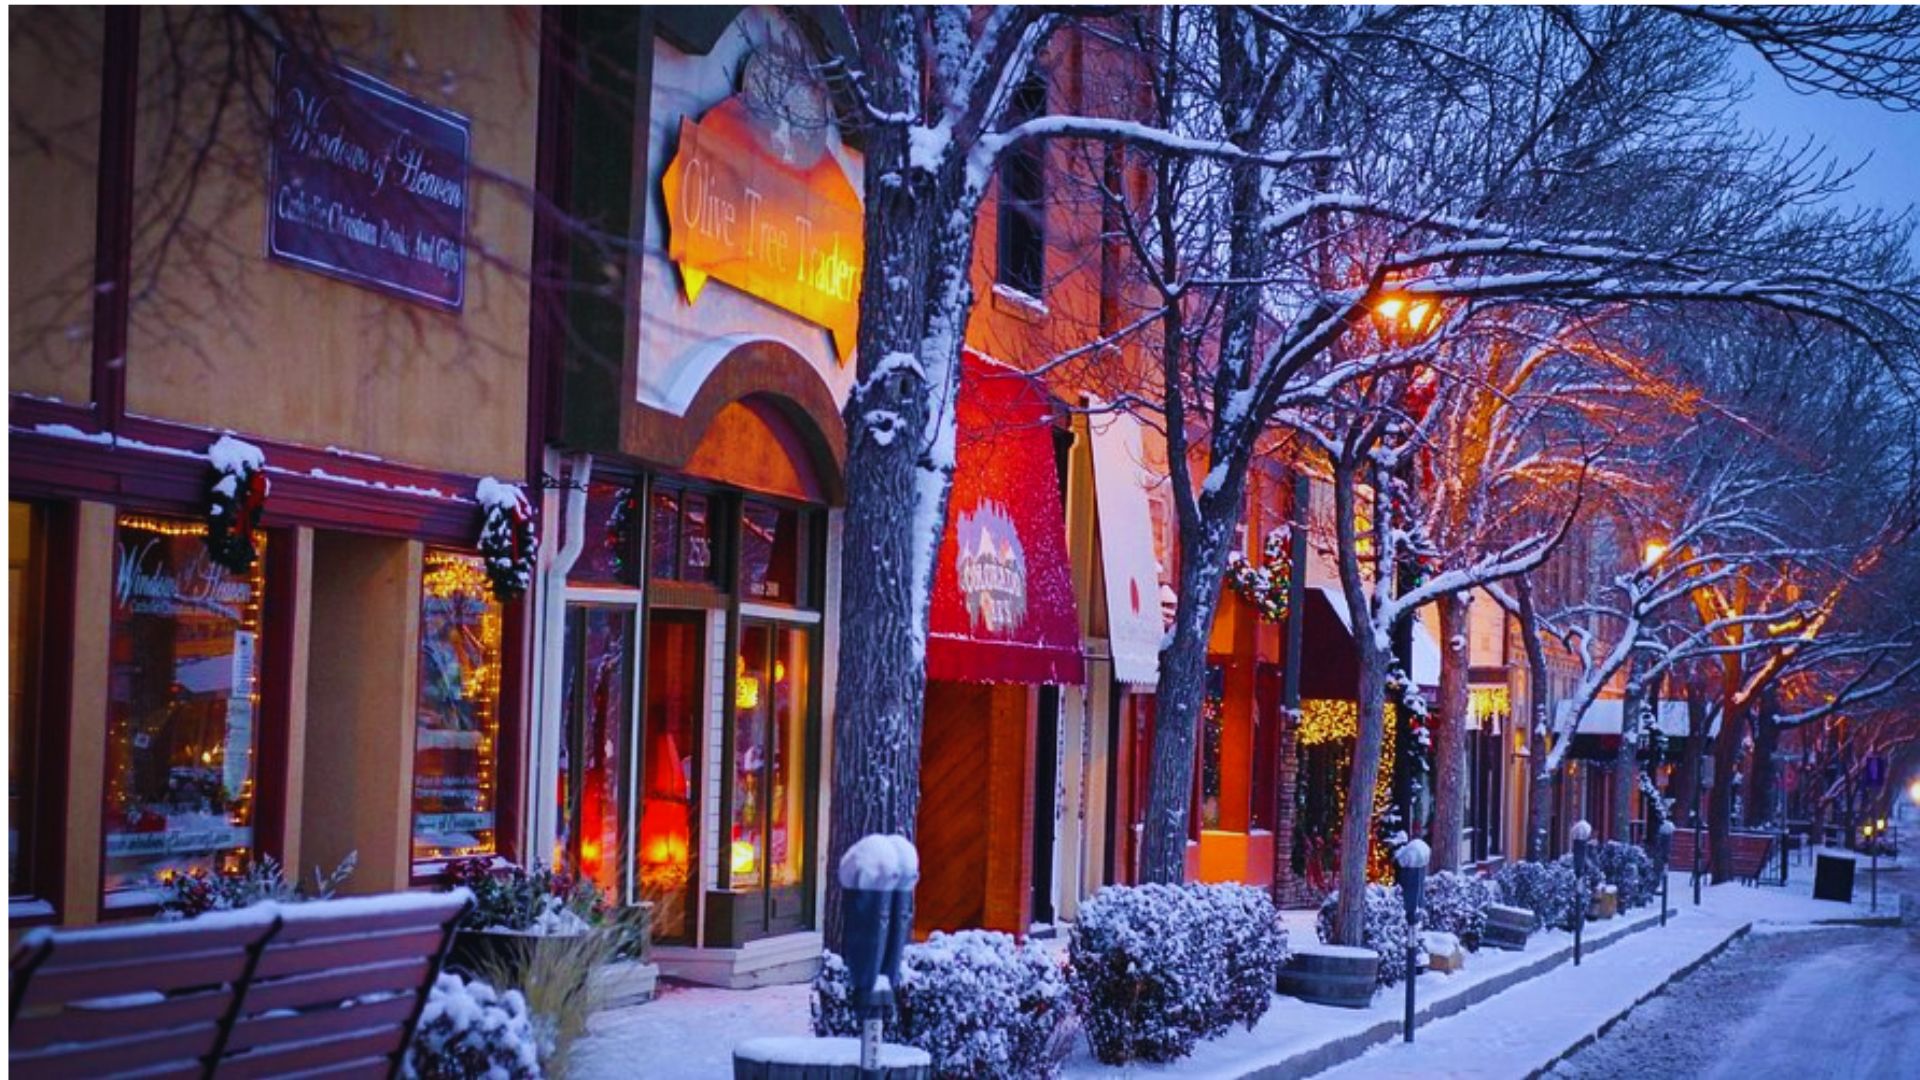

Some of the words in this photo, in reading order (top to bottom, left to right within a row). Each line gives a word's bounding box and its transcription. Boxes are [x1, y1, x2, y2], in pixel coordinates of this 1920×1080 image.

[284, 88, 370, 173] Windows
[371, 142, 394, 196] of
[395, 133, 463, 208] Heaven
[328, 202, 377, 246] Christian
[681, 157, 736, 247] Olive
[744, 187, 788, 272] Tree
